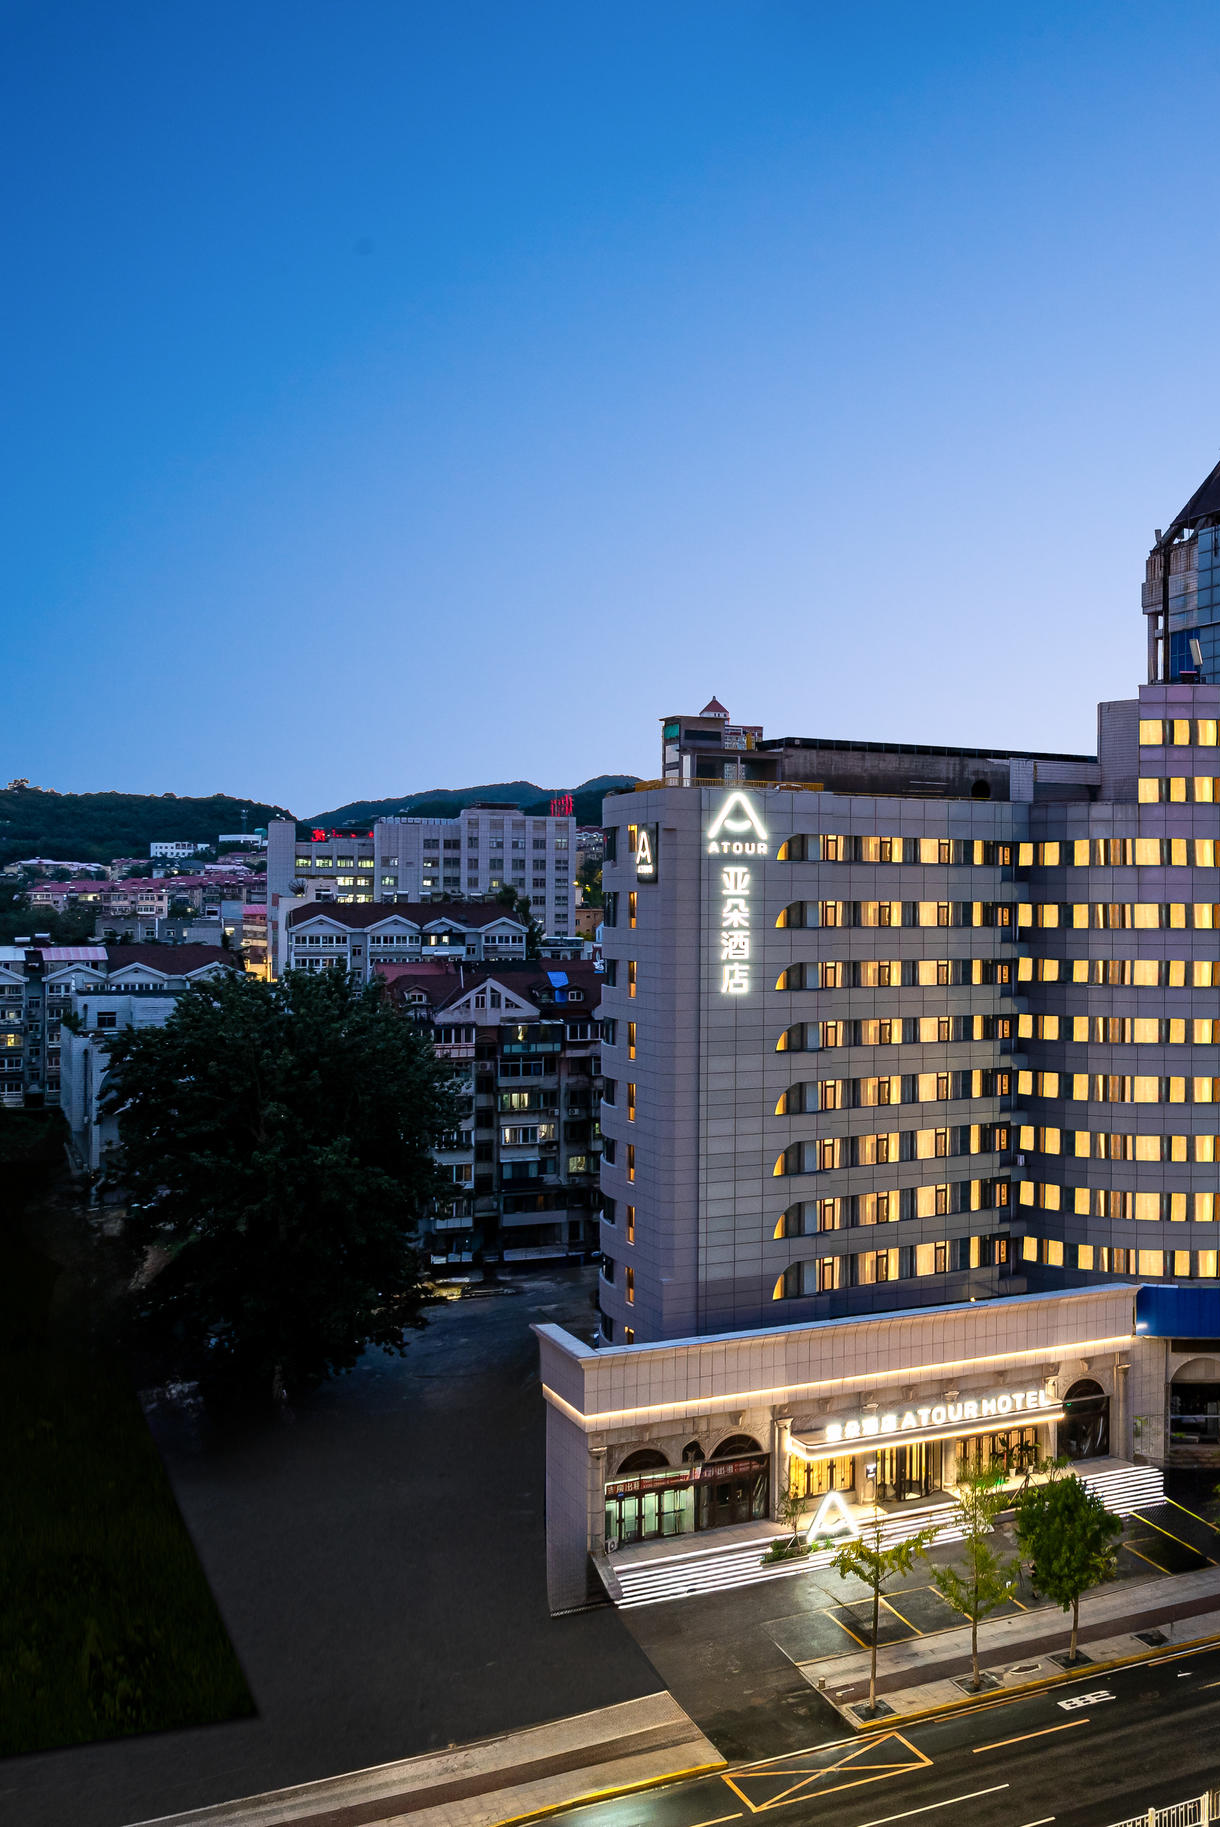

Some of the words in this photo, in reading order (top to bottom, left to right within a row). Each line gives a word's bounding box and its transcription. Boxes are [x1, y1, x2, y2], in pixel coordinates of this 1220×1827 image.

[707, 841, 768, 855] ATOUR
[720, 866, 750, 994] 亚朵酒店
[900, 1400, 978, 1430] ATOUR
[981, 1389, 1049, 1416] HOTEL
